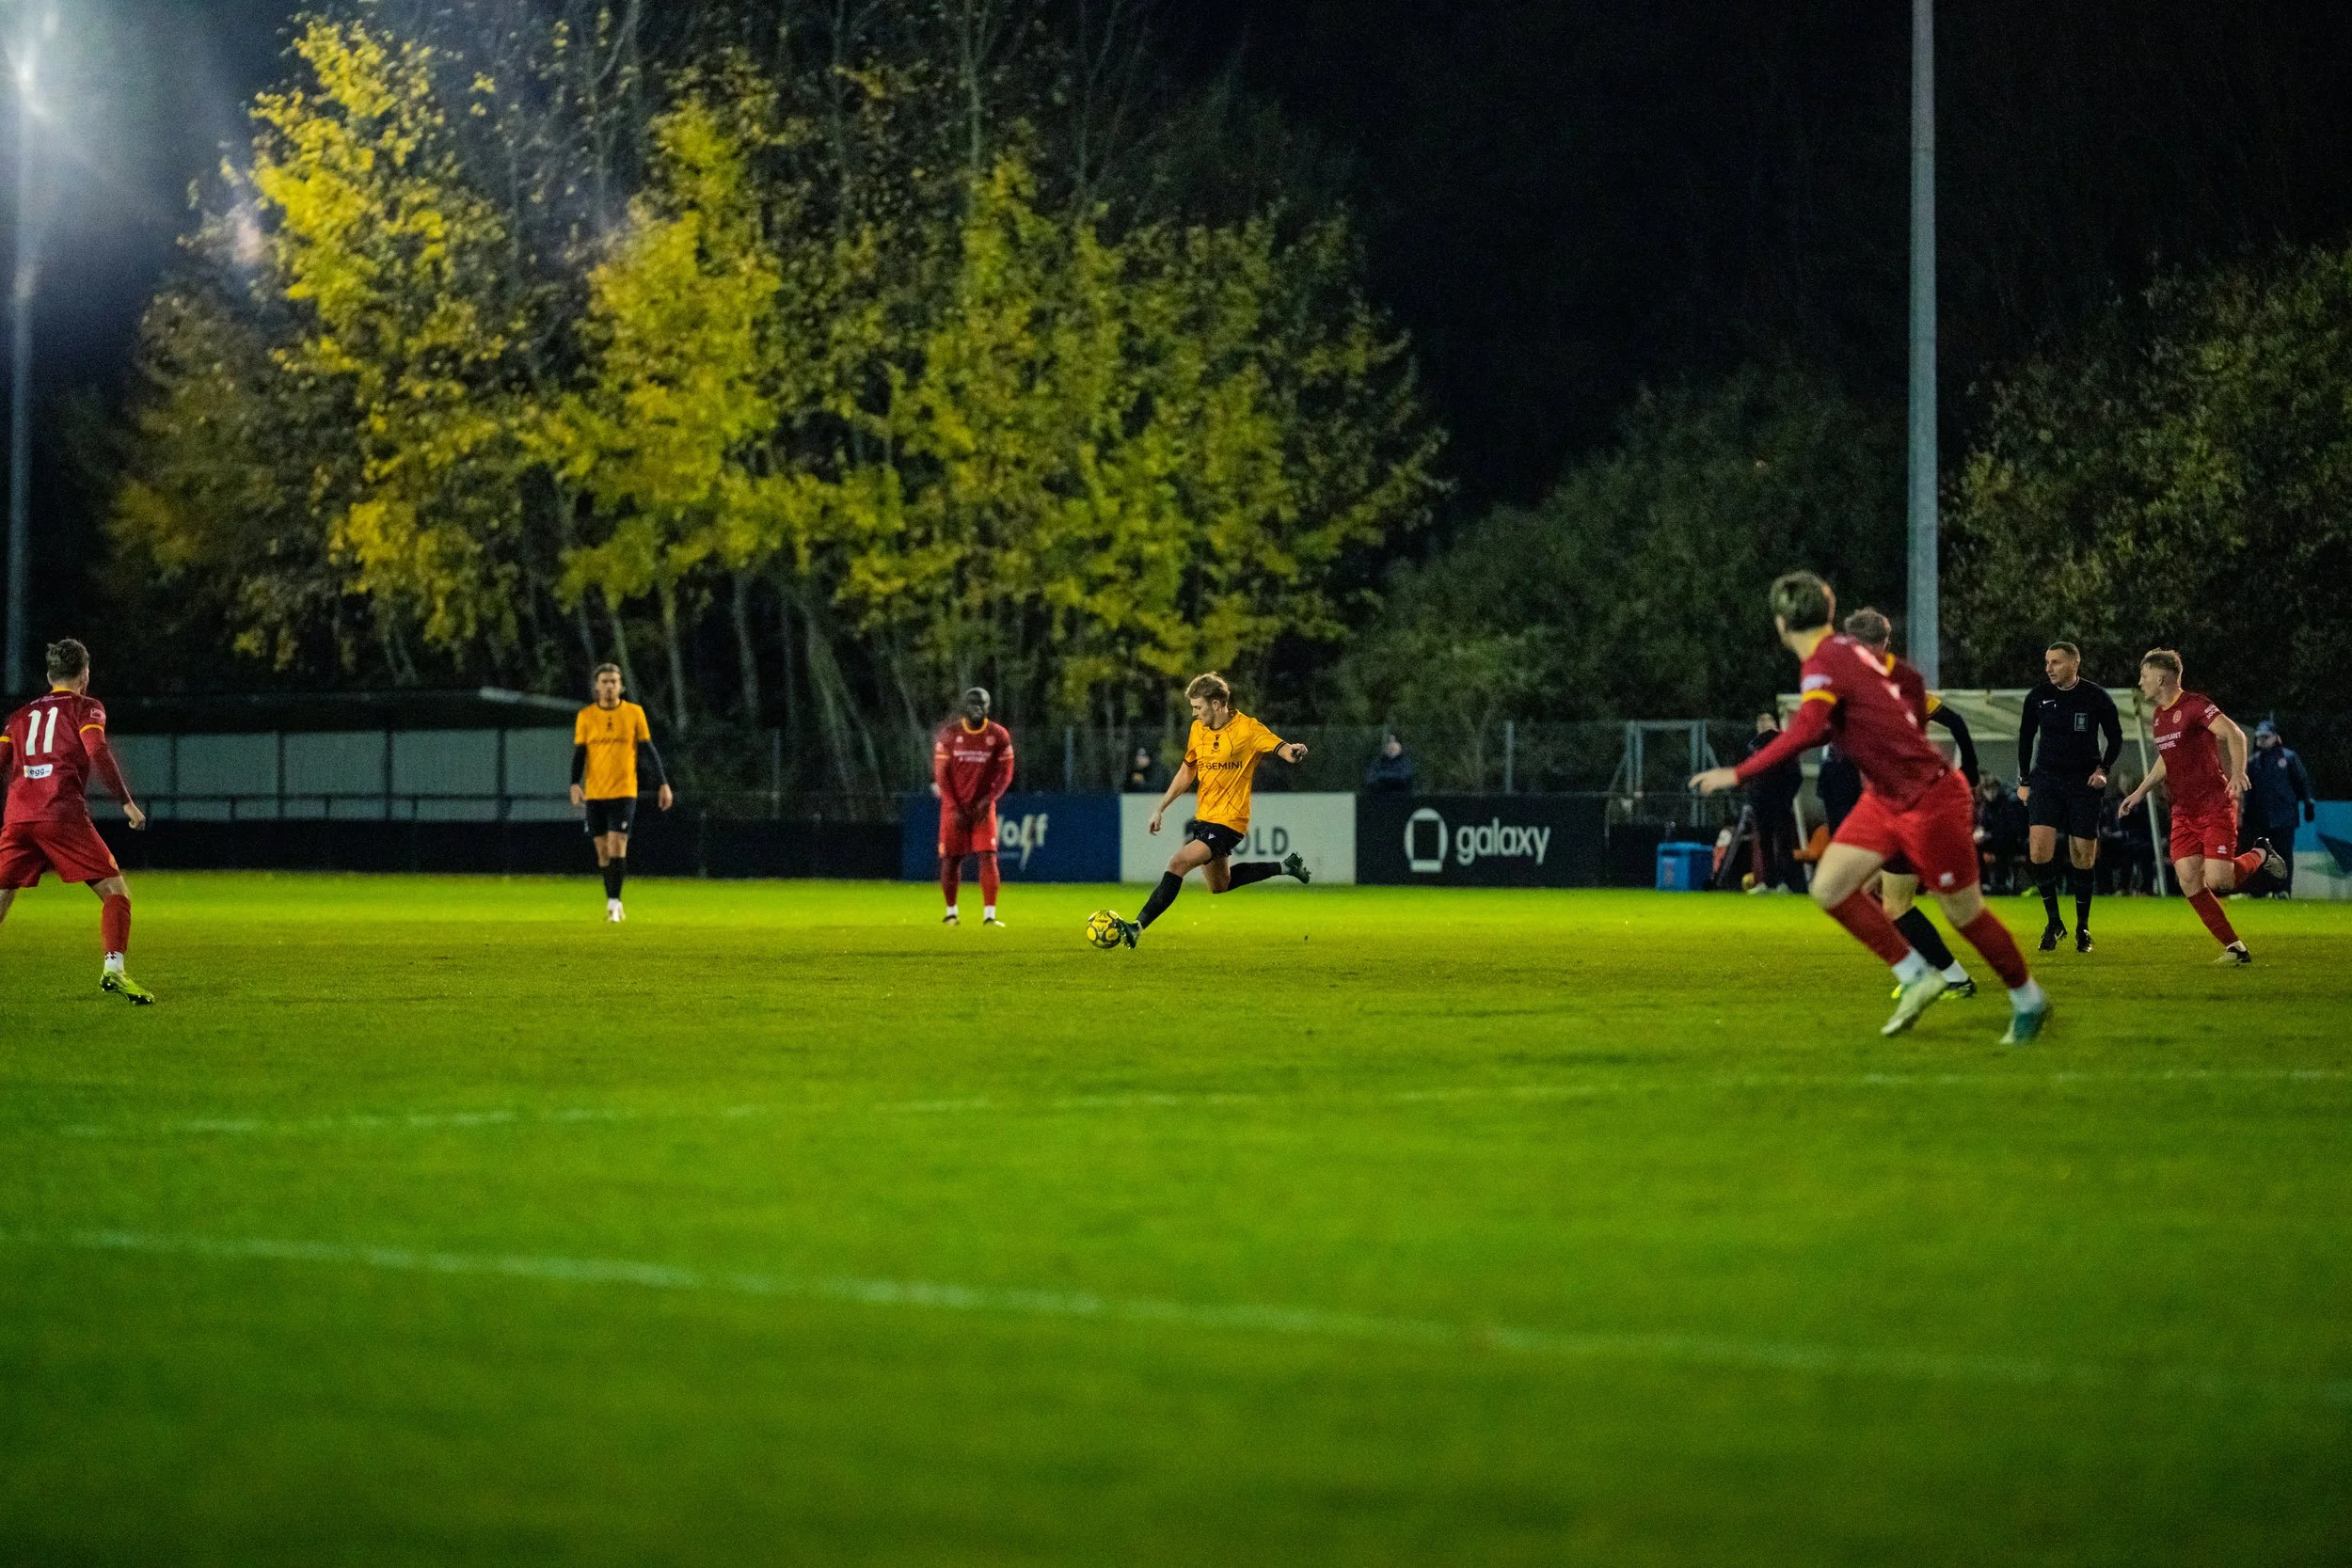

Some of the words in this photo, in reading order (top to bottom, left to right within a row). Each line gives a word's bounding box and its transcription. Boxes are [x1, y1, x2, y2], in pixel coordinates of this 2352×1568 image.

[25, 706, 58, 756] 11
[1205, 760, 1243, 770] GEMINI
[1455, 816, 1550, 865] galaxy
